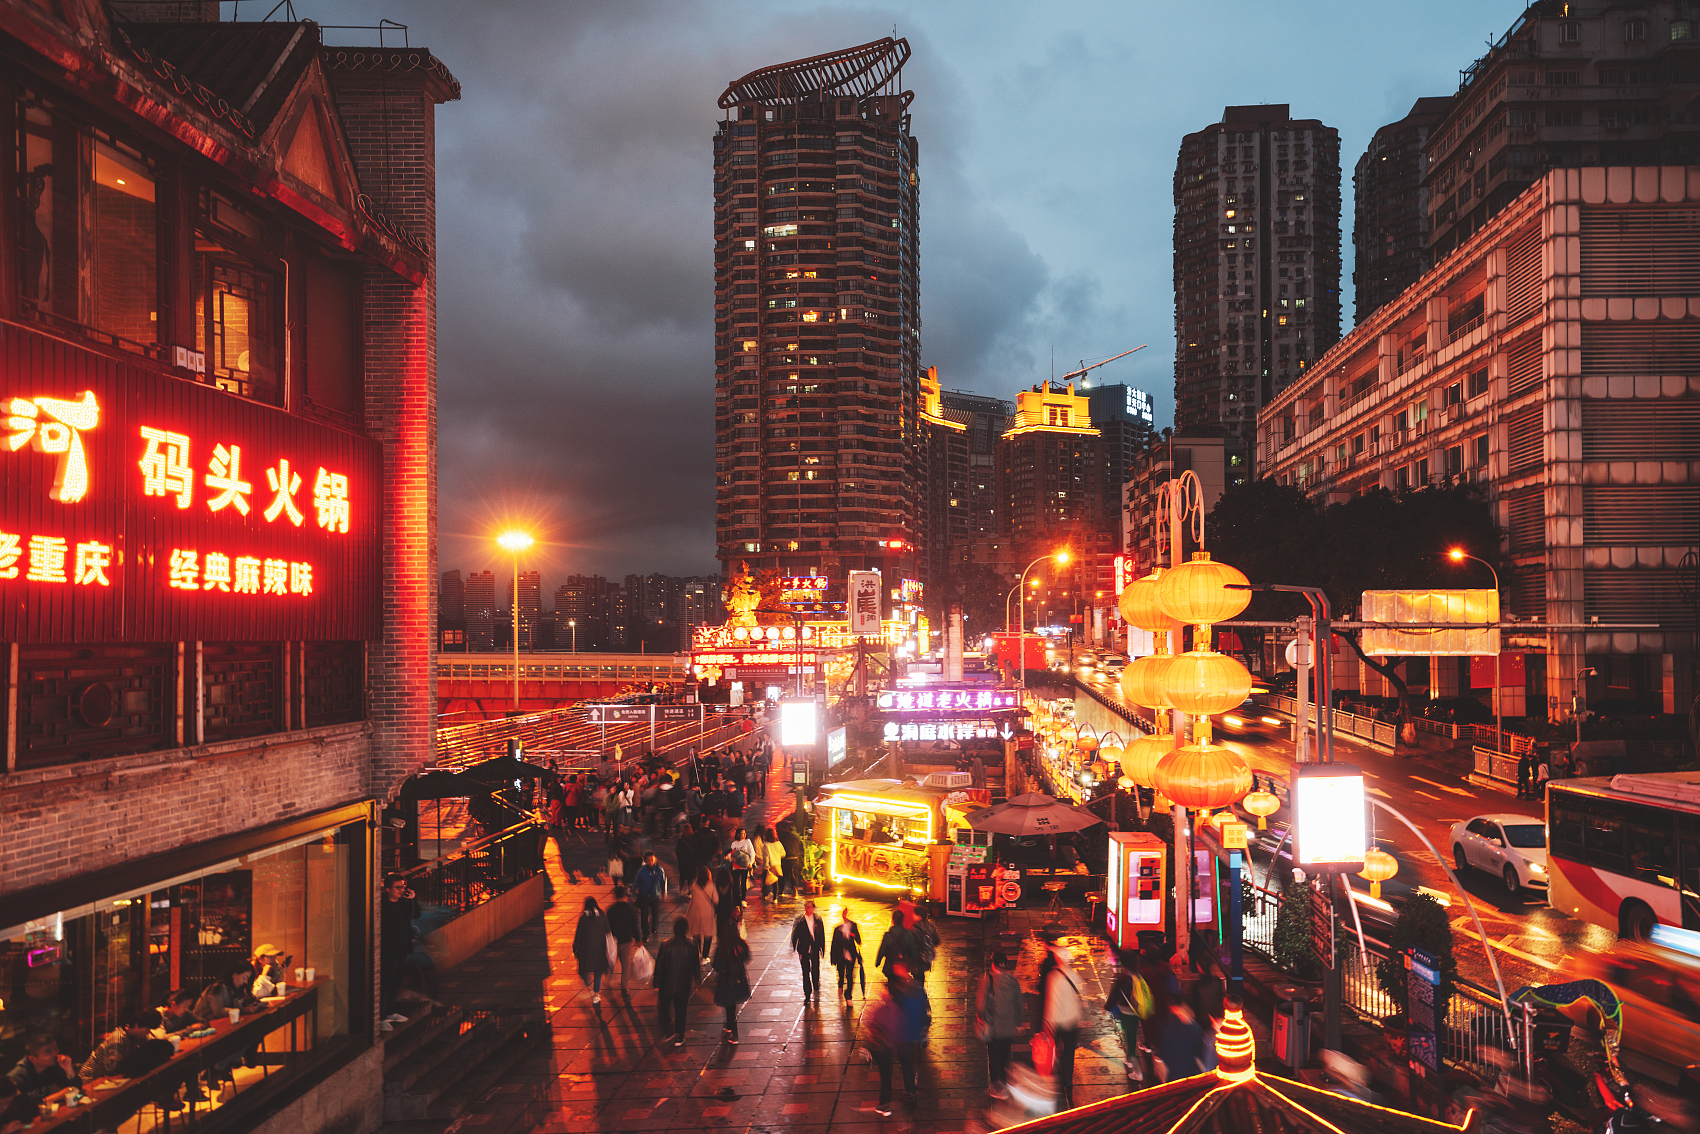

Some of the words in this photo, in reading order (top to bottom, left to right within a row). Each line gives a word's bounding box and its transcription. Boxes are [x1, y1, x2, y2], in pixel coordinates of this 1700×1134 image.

[138, 425, 351, 534] 码头火锅
[169, 548, 313, 597] 经典麻辣味
